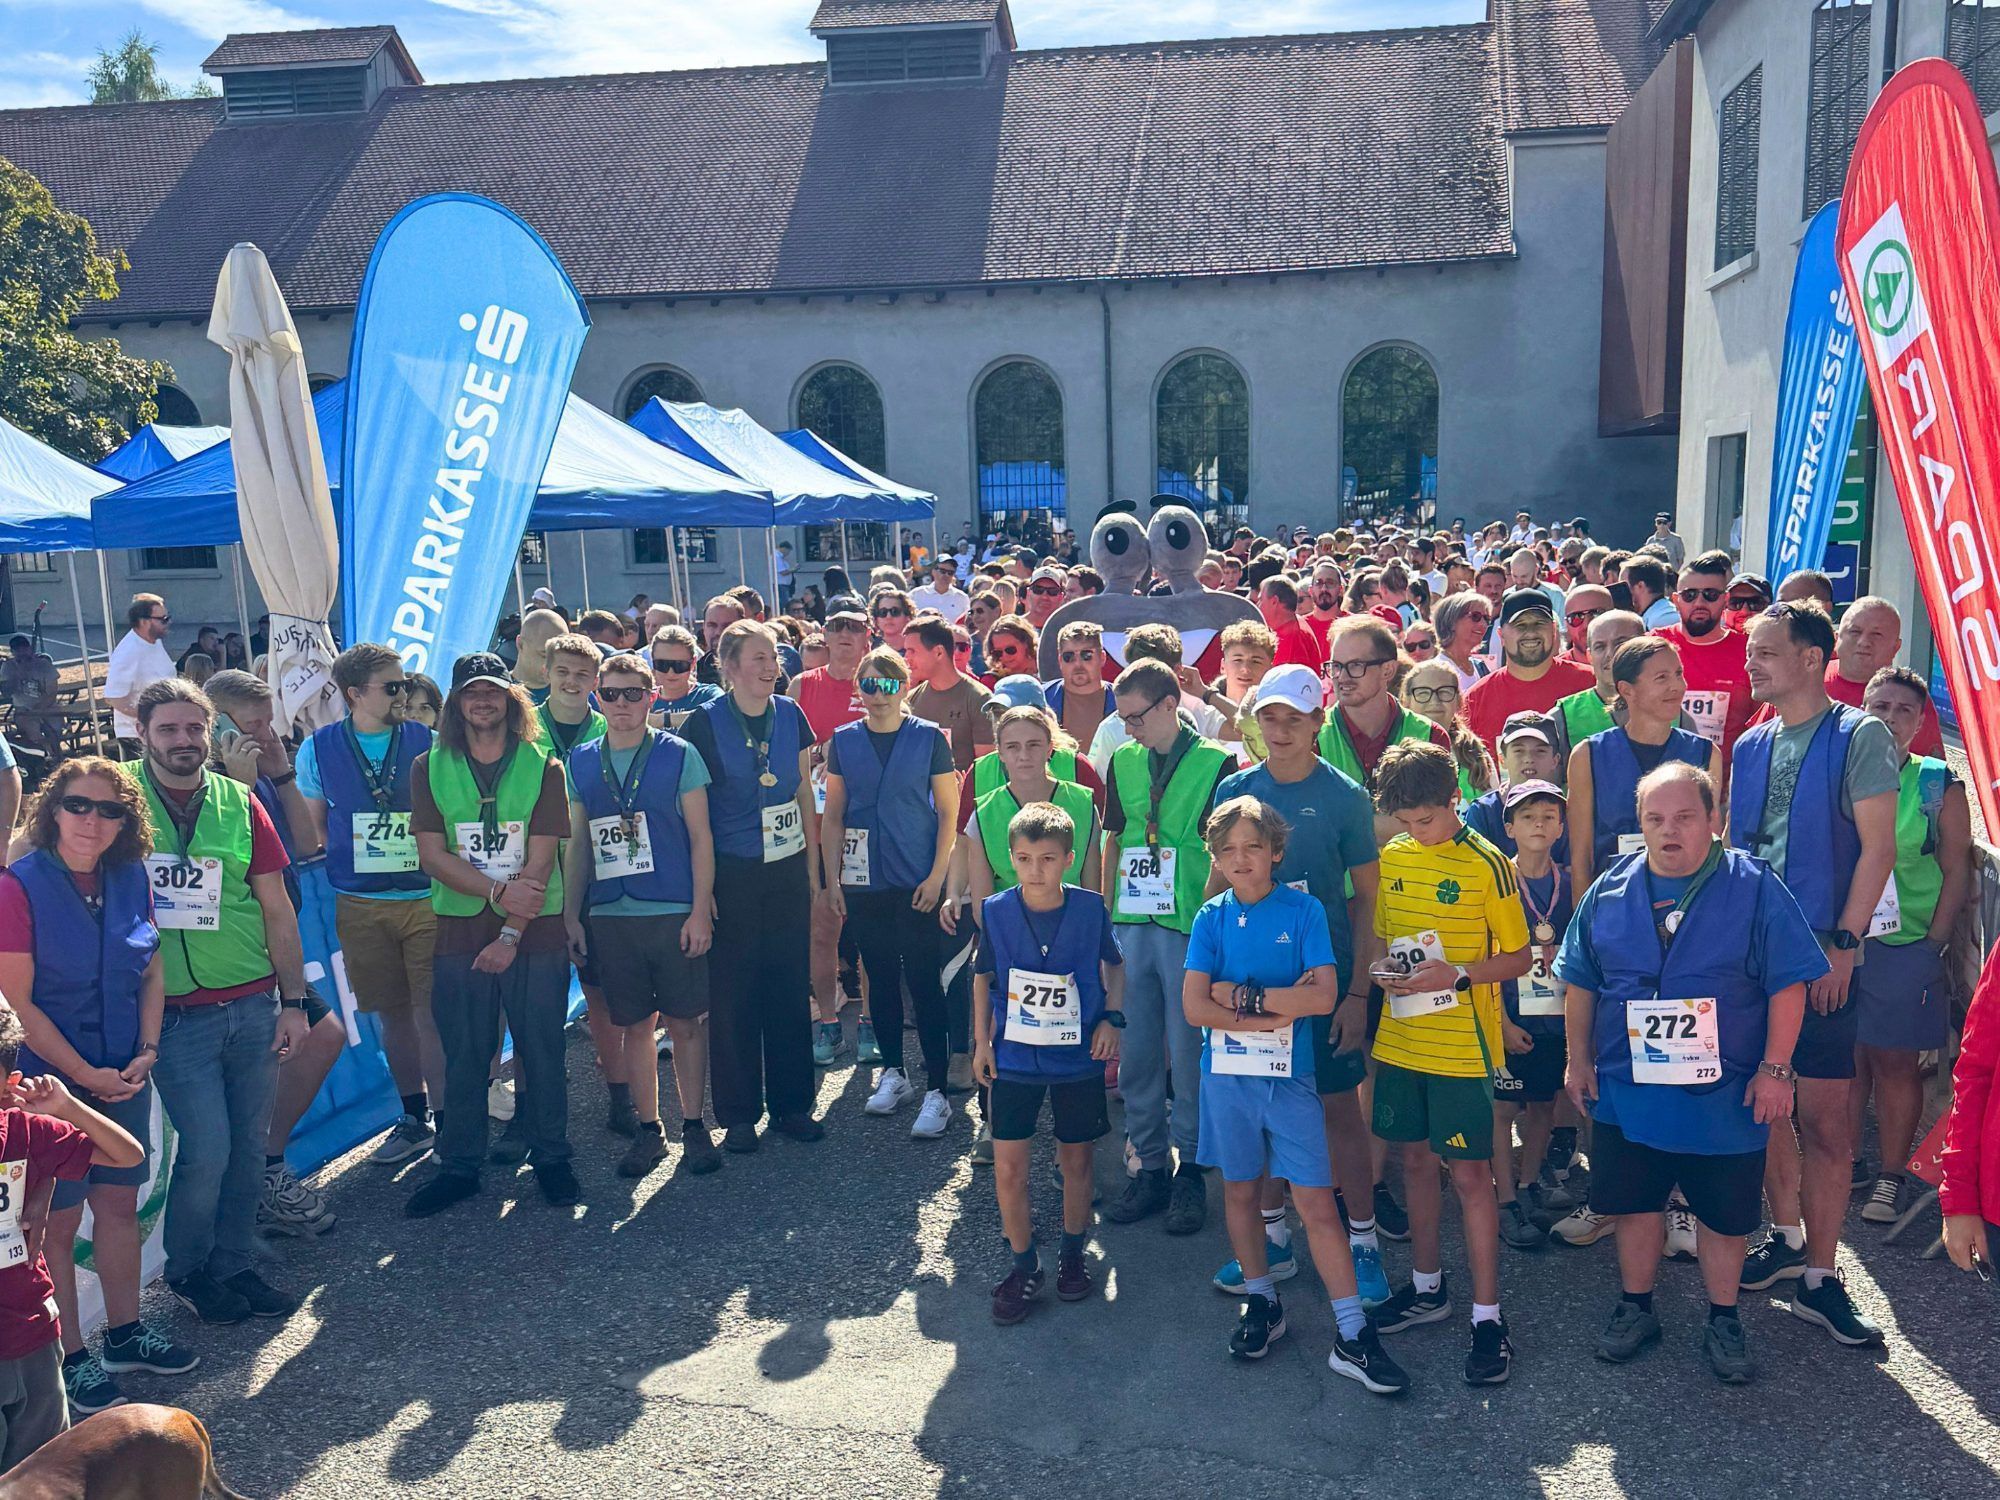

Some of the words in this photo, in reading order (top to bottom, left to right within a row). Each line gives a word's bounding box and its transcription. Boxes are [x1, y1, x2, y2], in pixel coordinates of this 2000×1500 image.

[1781, 327, 1849, 570] SPARKASSE
[386, 362, 511, 673] SPARKASSE
[1683, 699, 1714, 715] 191
[774, 810, 798, 831] 301
[368, 823, 406, 840] 274
[599, 825, 635, 847] 26
[635, 861, 650, 869] 269
[1129, 859, 1161, 878] 264
[154, 866, 203, 889] 302
[1157, 903, 1171, 911] 264
[197, 917, 214, 926] 302
[1881, 920, 1897, 931] 318
[1391, 948, 1426, 974] 39
[1023, 984, 1067, 1008] 275
[1433, 994, 1452, 1006] 239
[1645, 1014, 1697, 1039] 272
[1060, 1032, 1077, 1040] 275
[1270, 1062, 1287, 1071] 142
[1696, 1068, 1716, 1078] 272
[8, 1245, 24, 1259] 133
